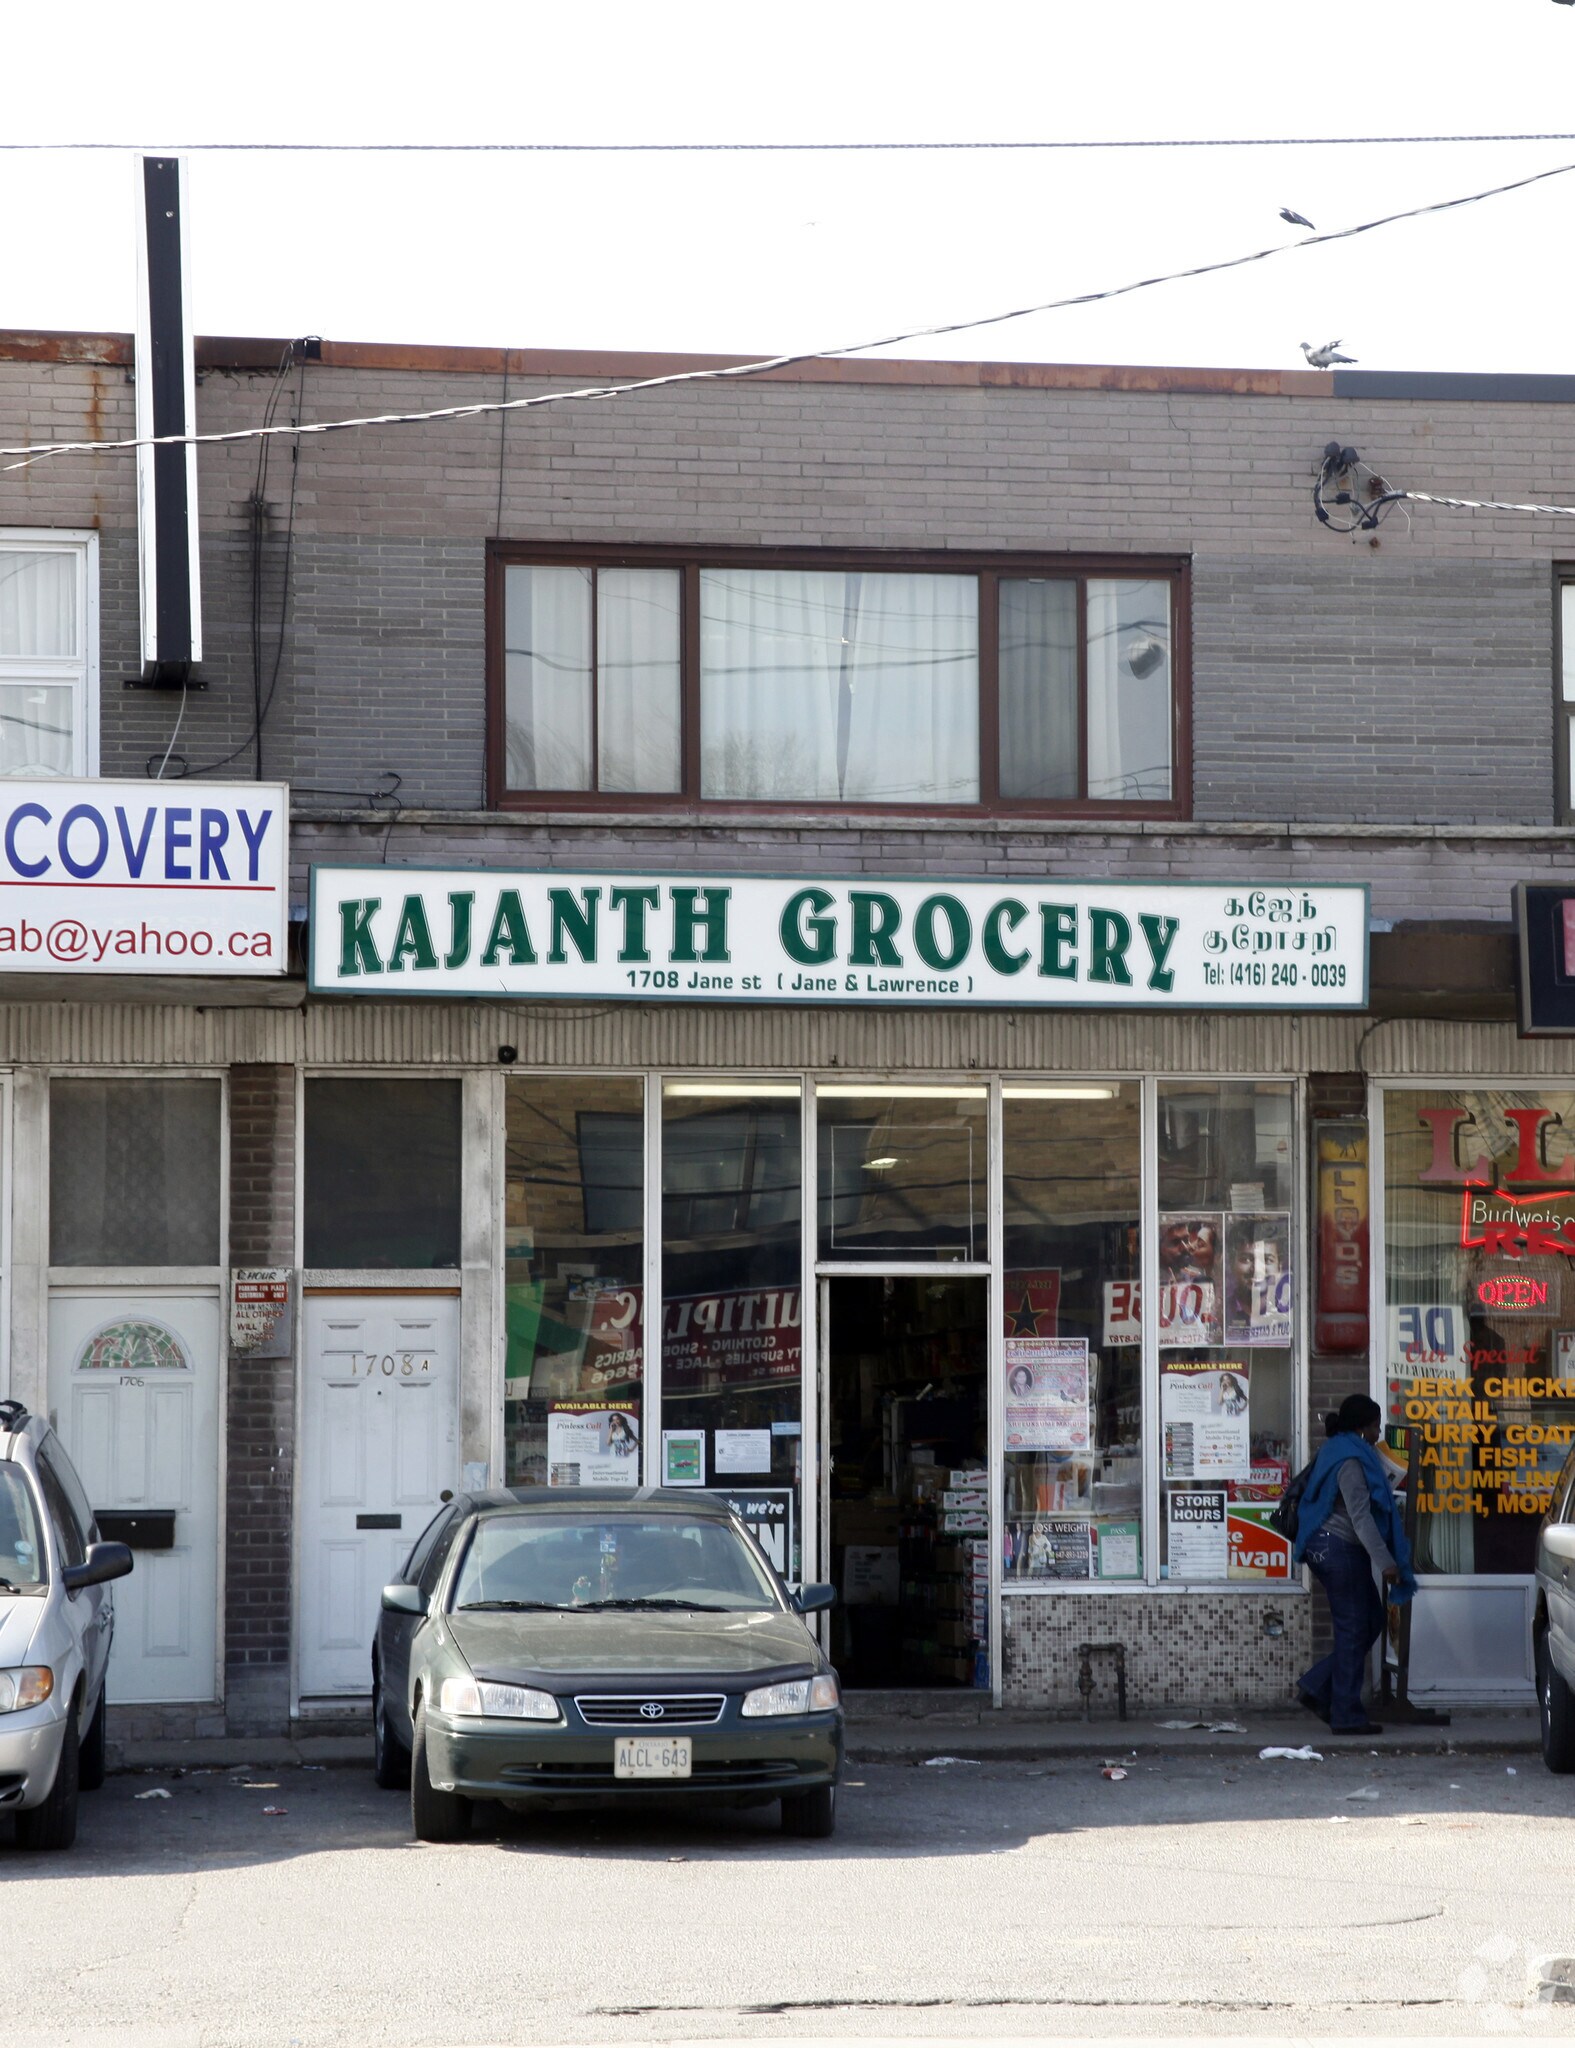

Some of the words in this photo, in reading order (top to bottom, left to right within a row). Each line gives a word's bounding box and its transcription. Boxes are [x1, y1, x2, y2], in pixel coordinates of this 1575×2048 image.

[4, 802, 273, 882] COVERY
[337, 884, 732, 978] KAJANTH
[778, 886, 1180, 993] GROCERY
[626, 970, 679, 988] 1708
[687, 971, 733, 989] Jane
[741, 975, 762, 989] st
[791, 972, 837, 991] Jane
[844, 973, 858, 991] &
[866, 974, 960, 993] Lawrence
[1203, 962, 1225, 985] Tel:
[1230, 962, 1266, 986] (416)
[1271, 963, 1297, 986] 240
[1311, 964, 1346, 987] 0039
[1477, 1280, 1548, 1306] OPEN
[350, 1353, 414, 1376] 1708
[1219, 1362, 1243, 1370] HERE
[1405, 1340, 1448, 1364] Our
[1459, 1340, 1541, 1371] Special
[1404, 1377, 1475, 1398] JERK
[553, 1402, 607, 1410] AVAILABLE
[608, 1402, 633, 1410] HERE
[1404, 1400, 1498, 1421] OXTAIL
[1419, 1447, 1470, 1467] ALT
[1479, 1447, 1538, 1467] FISH
[746, 1500, 785, 1515] we're
[1176, 1495, 1219, 1507] STORE
[1174, 1509, 1221, 1520] HOURS
[1033, 1523, 1053, 1532] LOSE
[619, 1748, 653, 1768] ALCL
[662, 1748, 688, 1768] 643
